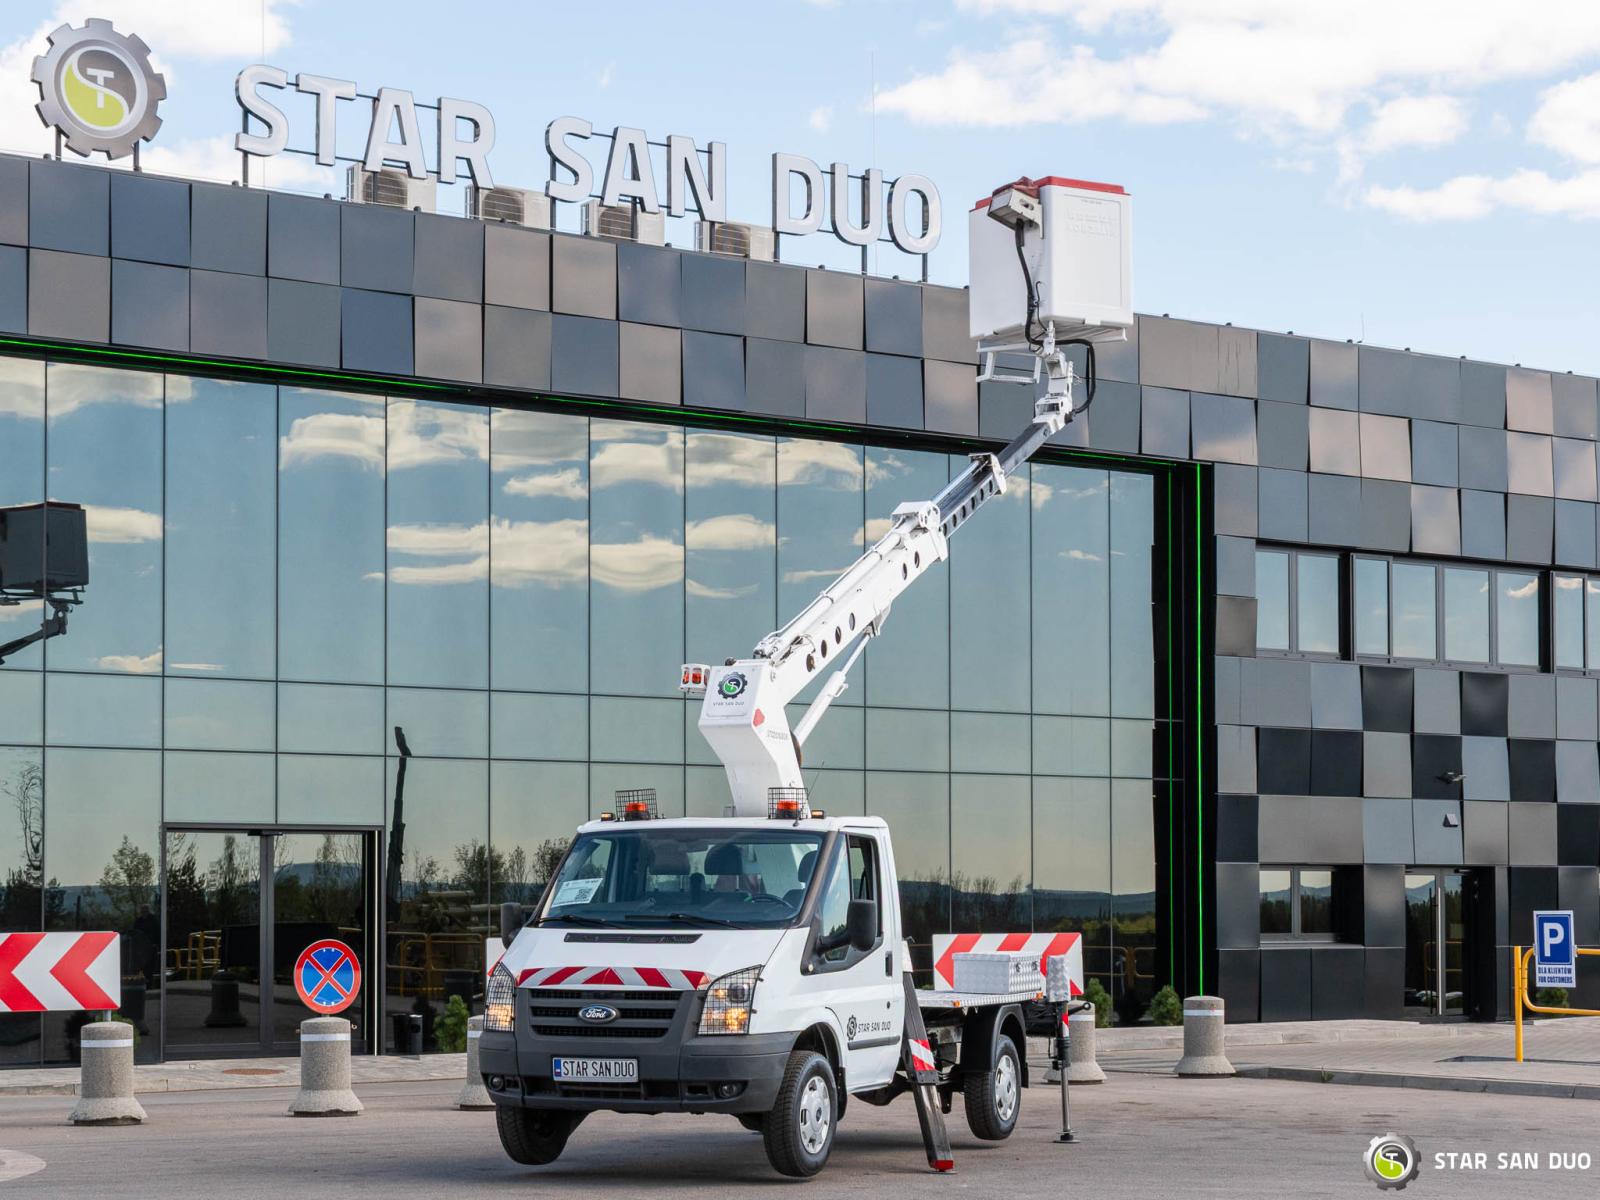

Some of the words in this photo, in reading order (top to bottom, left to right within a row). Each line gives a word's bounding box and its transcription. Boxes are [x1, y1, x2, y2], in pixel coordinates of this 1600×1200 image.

[235, 64, 496, 190] STAR
[545, 116, 727, 222] SAN
[772, 152, 942, 254] DUO
[1543, 922, 1565, 957] P
[585, 1008, 607, 1018] Ford
[858, 1023, 870, 1033] STAR
[871, 1022, 880, 1031] SAN
[881, 1021, 891, 1031] DUO
[562, 1061, 588, 1076] STAR
[591, 1061, 612, 1077] SAN
[614, 1061, 635, 1077] DUO
